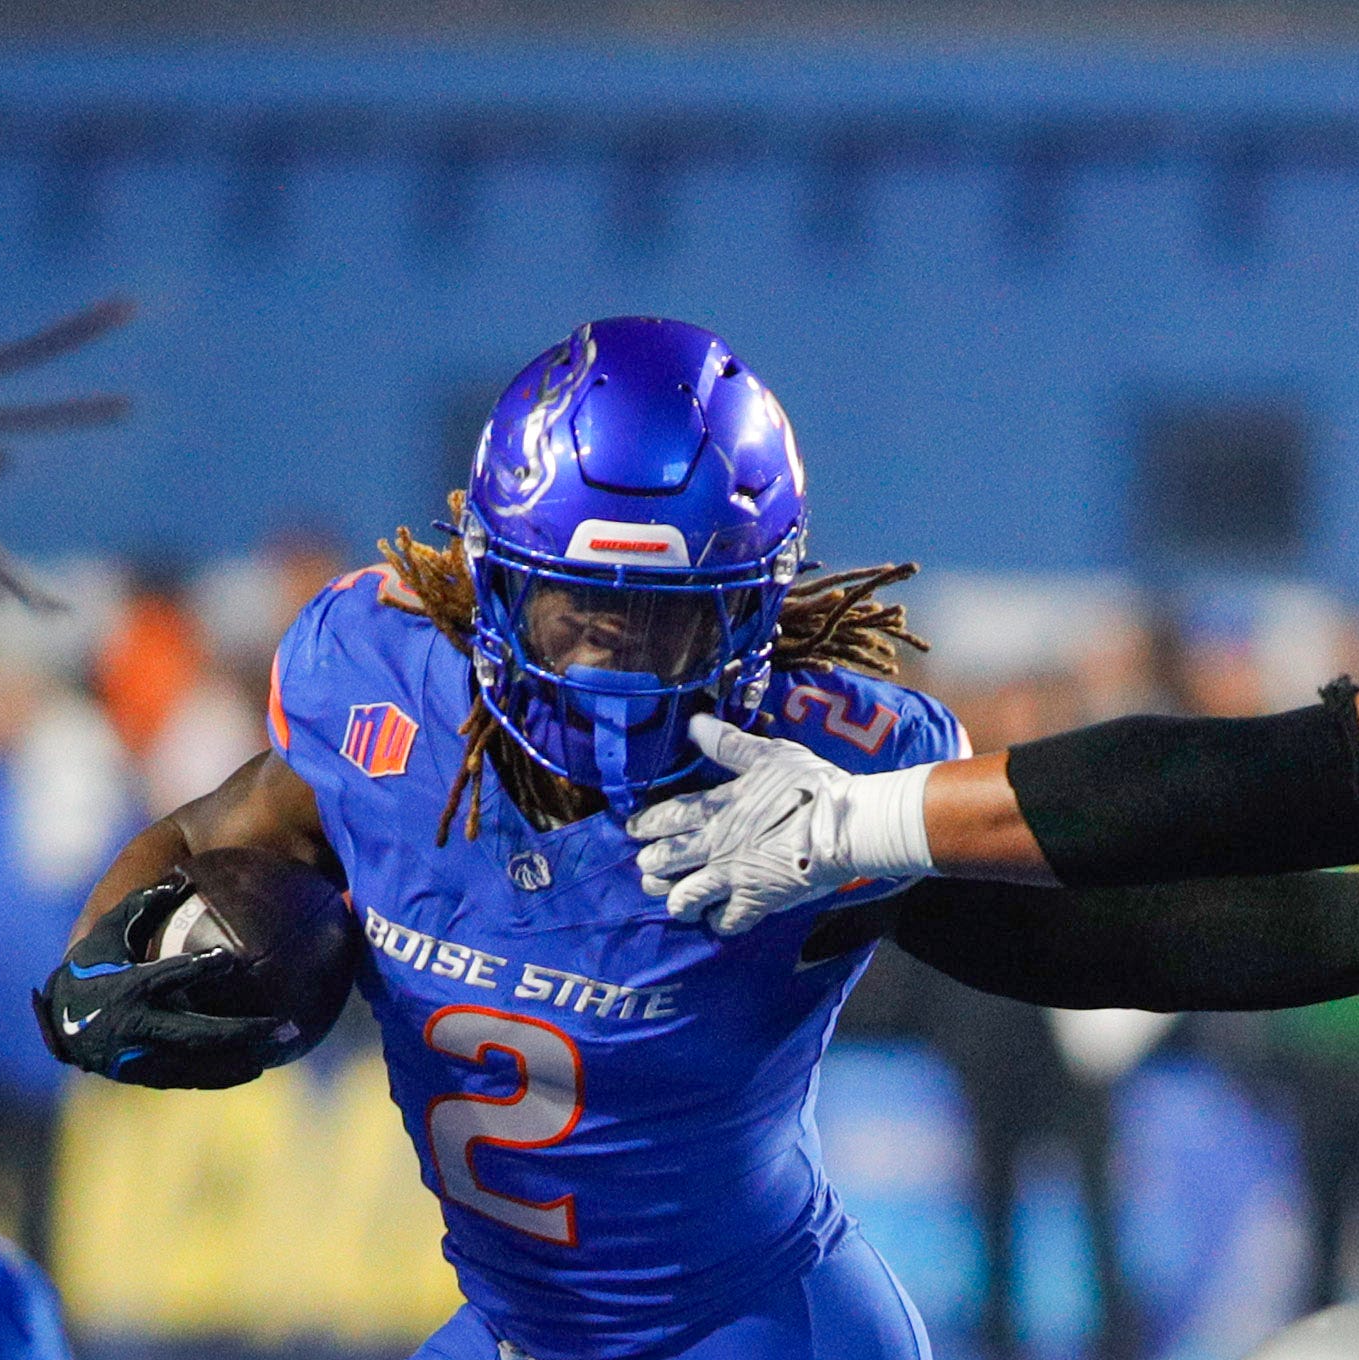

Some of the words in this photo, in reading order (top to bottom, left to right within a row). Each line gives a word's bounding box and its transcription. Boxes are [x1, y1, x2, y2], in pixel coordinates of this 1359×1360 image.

[783, 684, 901, 756] 2
[364, 906, 508, 990] BOISE
[514, 962, 683, 1020] STATE
[423, 1003, 585, 1247] 2
